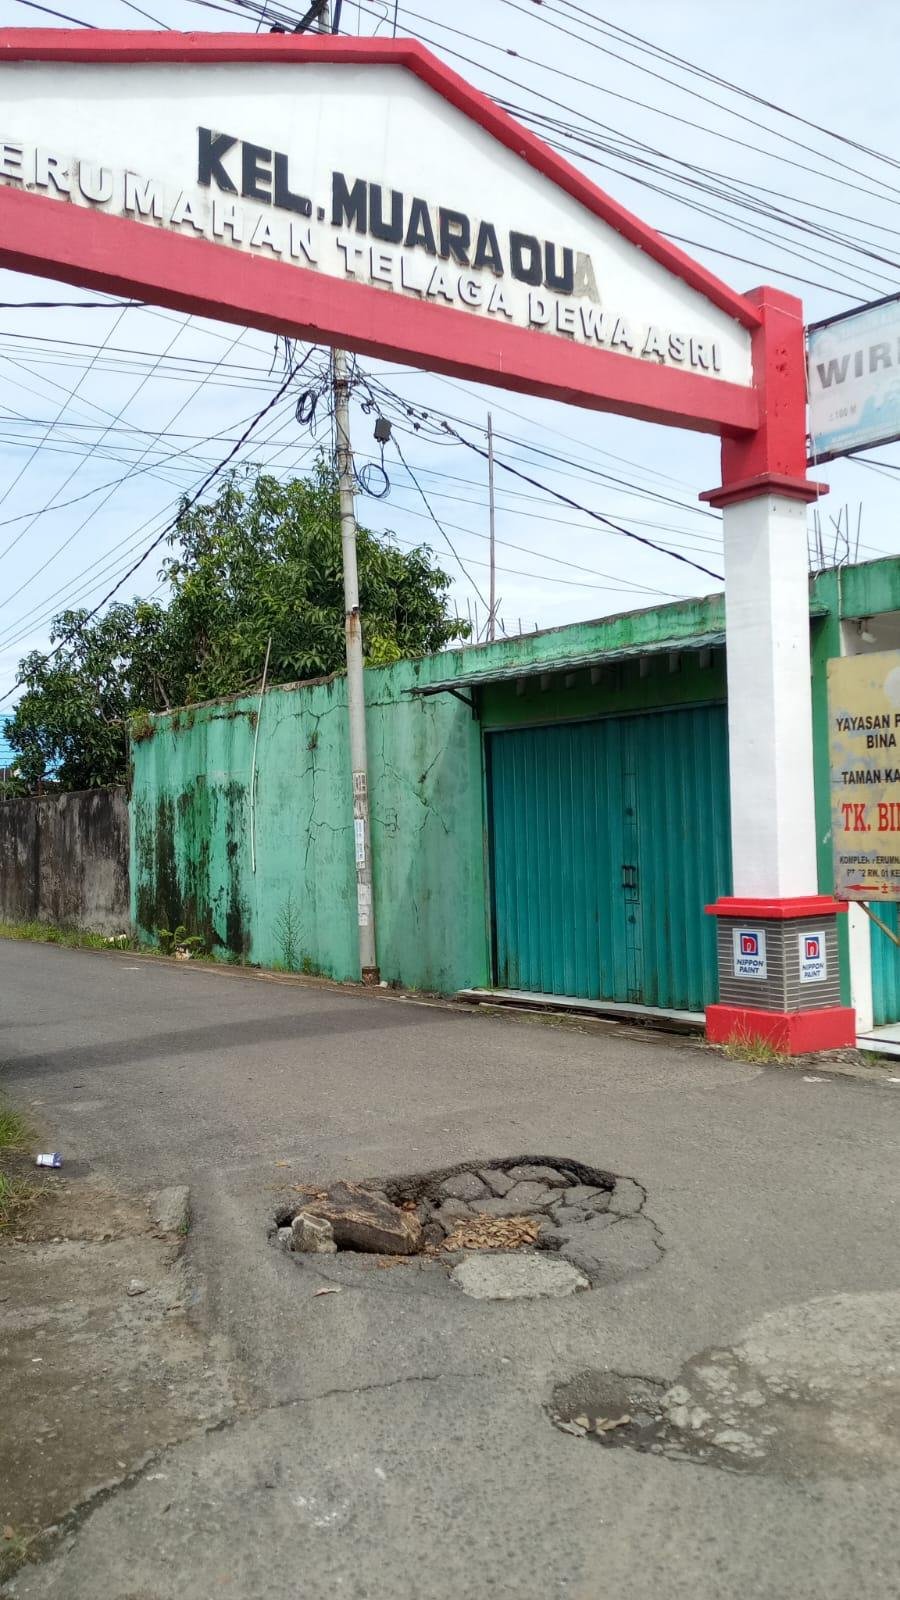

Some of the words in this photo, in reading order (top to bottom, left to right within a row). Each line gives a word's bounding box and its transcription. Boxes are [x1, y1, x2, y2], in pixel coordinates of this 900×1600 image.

[336, 236, 513, 318] TELAGA
[528, 290, 634, 350] DEWA
[641, 325, 722, 372] ASRI
[816, 336, 900, 389] WIR
[836, 714, 890, 732] YAYASAN
[866, 733, 897, 749] BINA
[841, 769, 882, 784] TAMAN
[841, 803, 871, 832] TK.
[736, 959, 764, 967] NIPPON
[804, 970, 821, 978] PAINT
